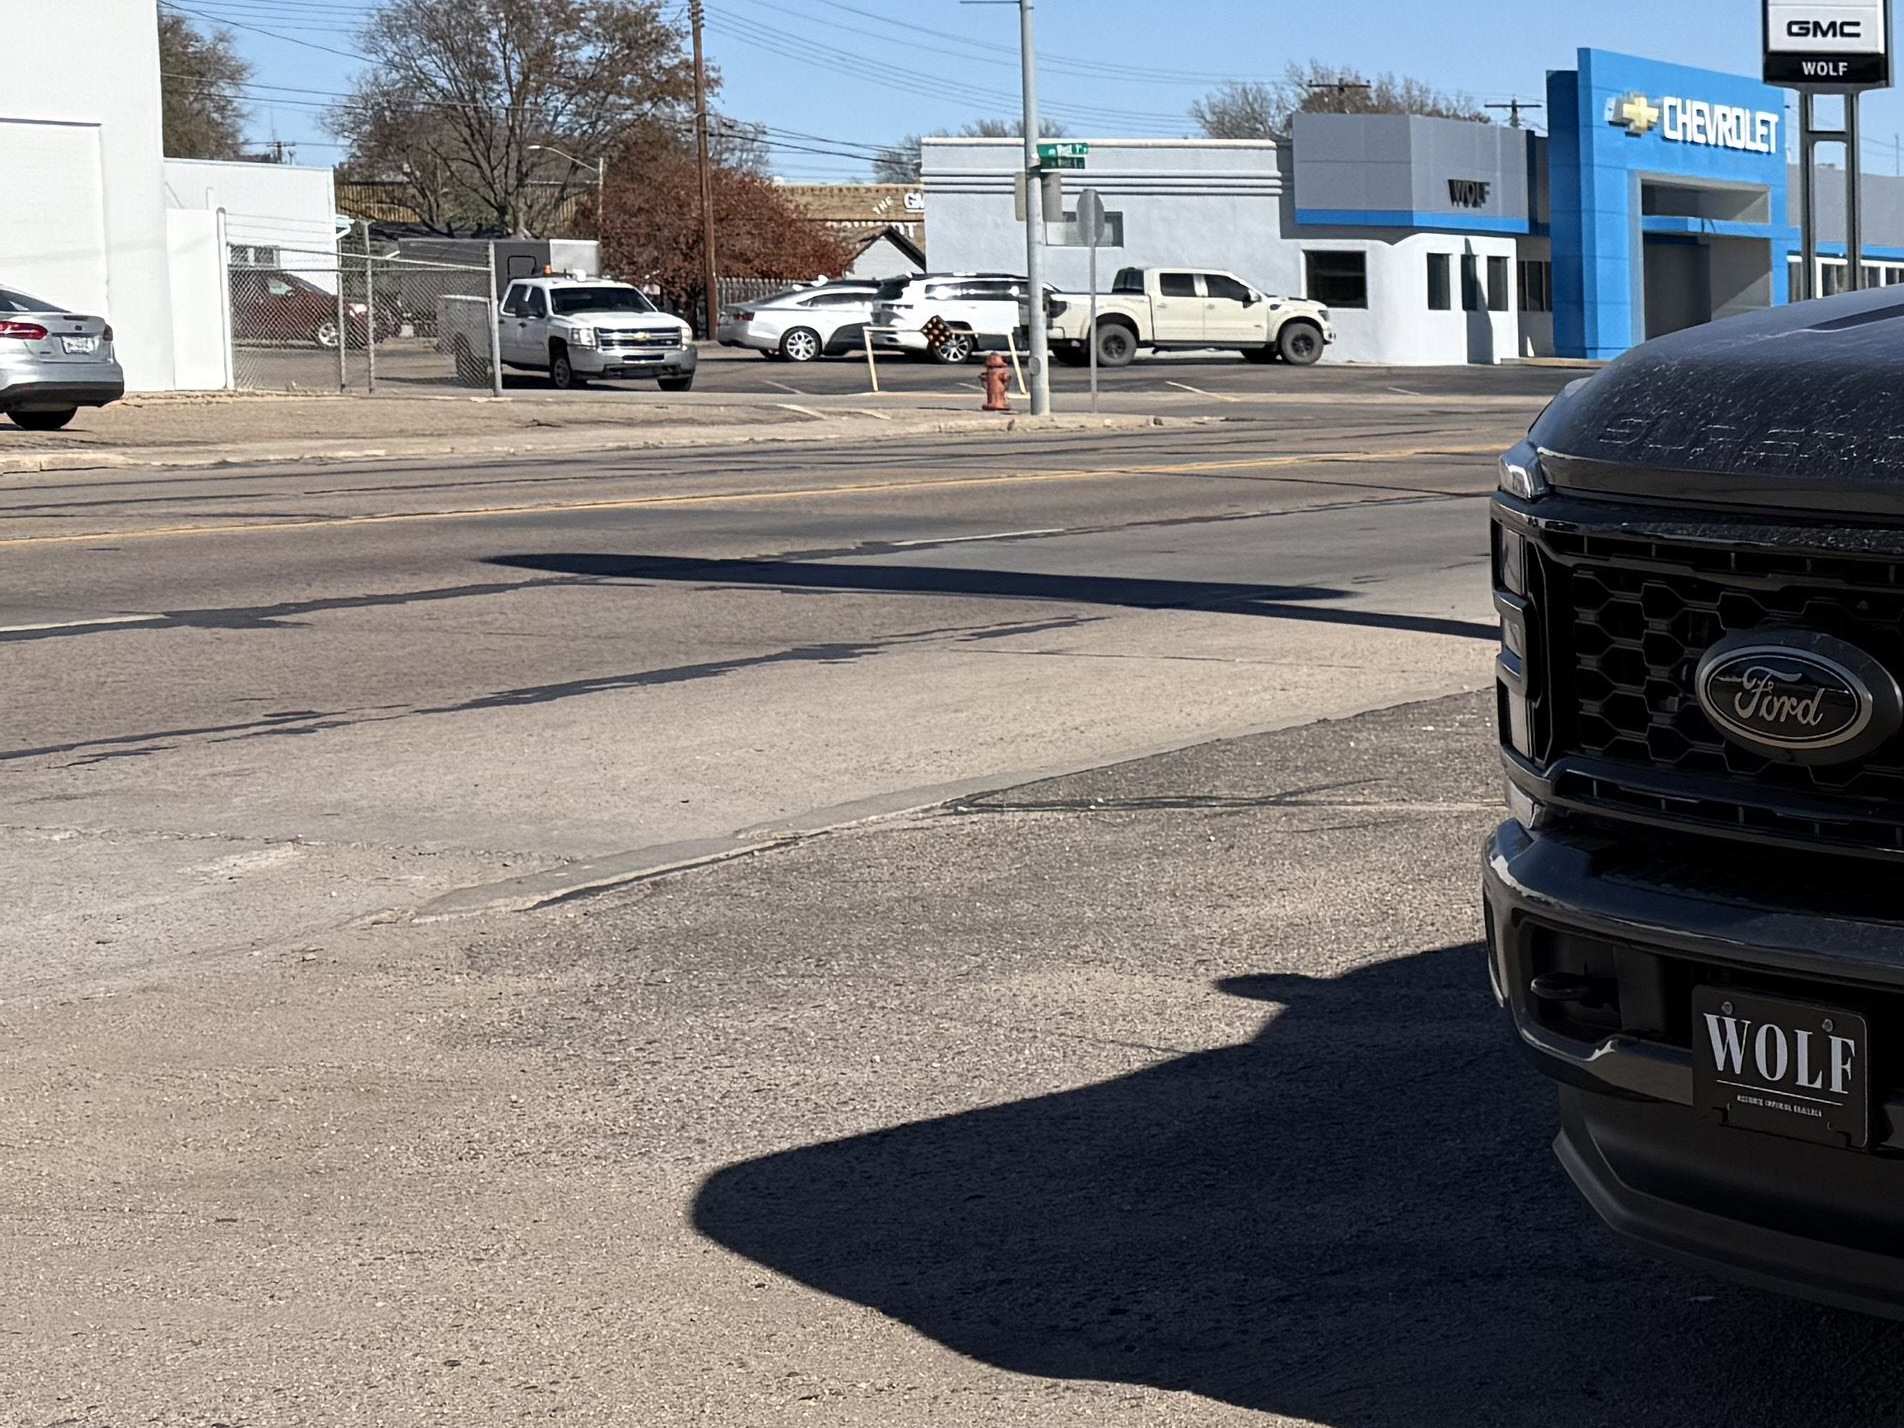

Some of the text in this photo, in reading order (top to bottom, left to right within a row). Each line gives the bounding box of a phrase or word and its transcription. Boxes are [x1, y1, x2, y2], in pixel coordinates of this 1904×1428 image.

[1787, 21, 1861, 38] GMC
[1802, 61, 1848, 76] WOLF
[1663, 96, 1779, 154] CHEVROLET
[1448, 179, 1490, 208] WOLF
[1734, 666, 1824, 727] Ford
[1703, 1012, 1856, 1094] WOLF
